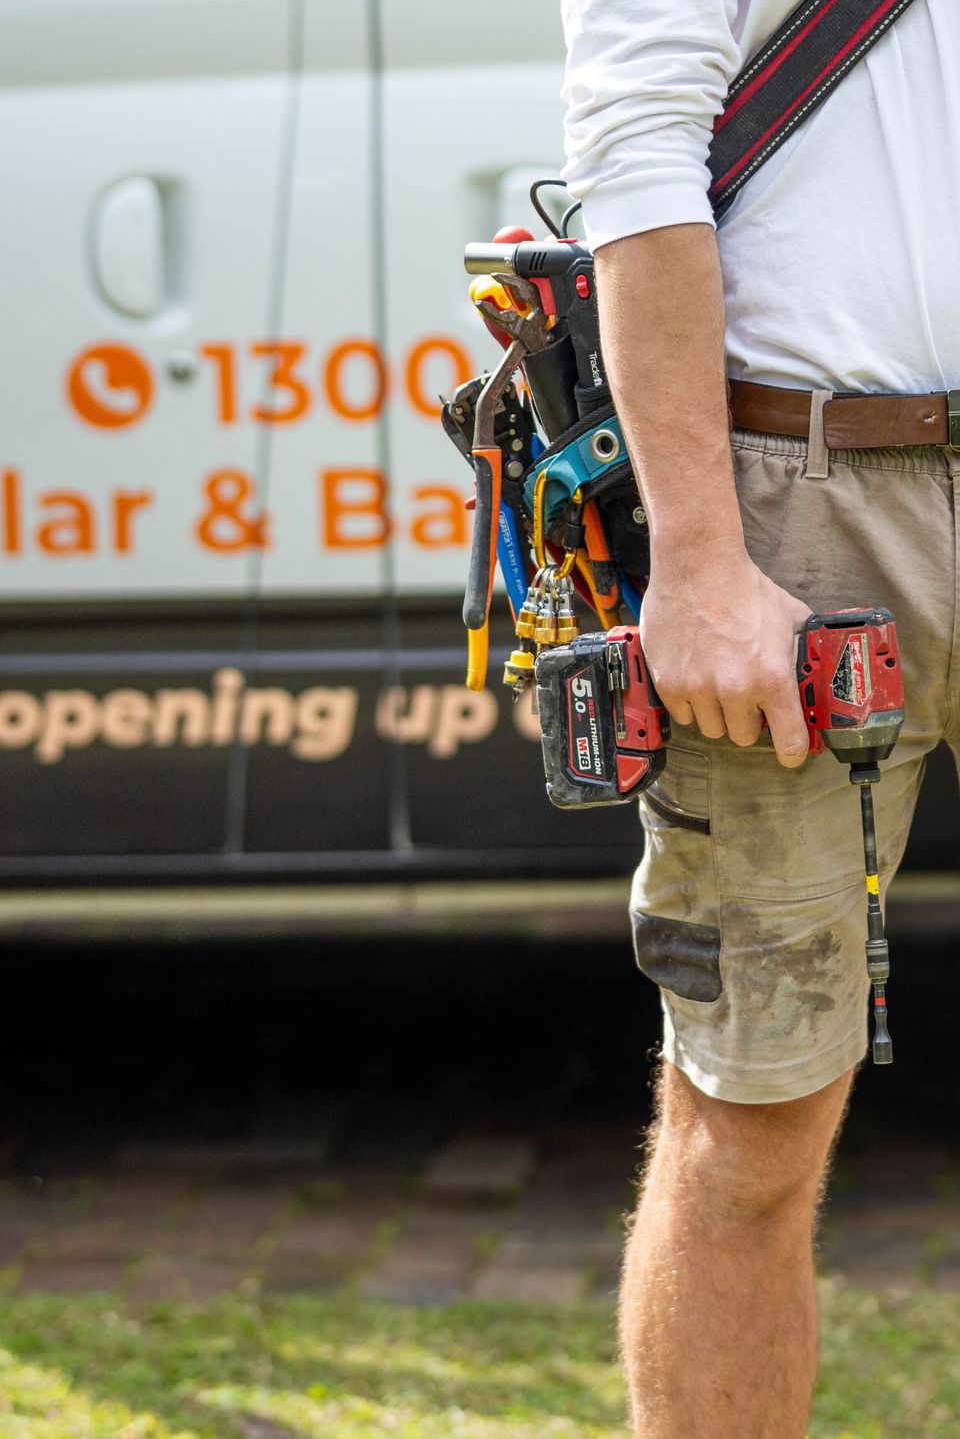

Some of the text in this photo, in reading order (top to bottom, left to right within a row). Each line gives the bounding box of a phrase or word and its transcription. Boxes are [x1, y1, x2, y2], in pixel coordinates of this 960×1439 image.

[198, 333, 472, 425] 1300
[2, 467, 154, 557] lar
[194, 467, 270, 553] &
[320, 465, 470, 552] Ba
[0, 667, 358, 763] opening
[376, 682, 500, 758] up
[571, 677, 593, 713] 5.0
[577, 738, 591, 769] M18
